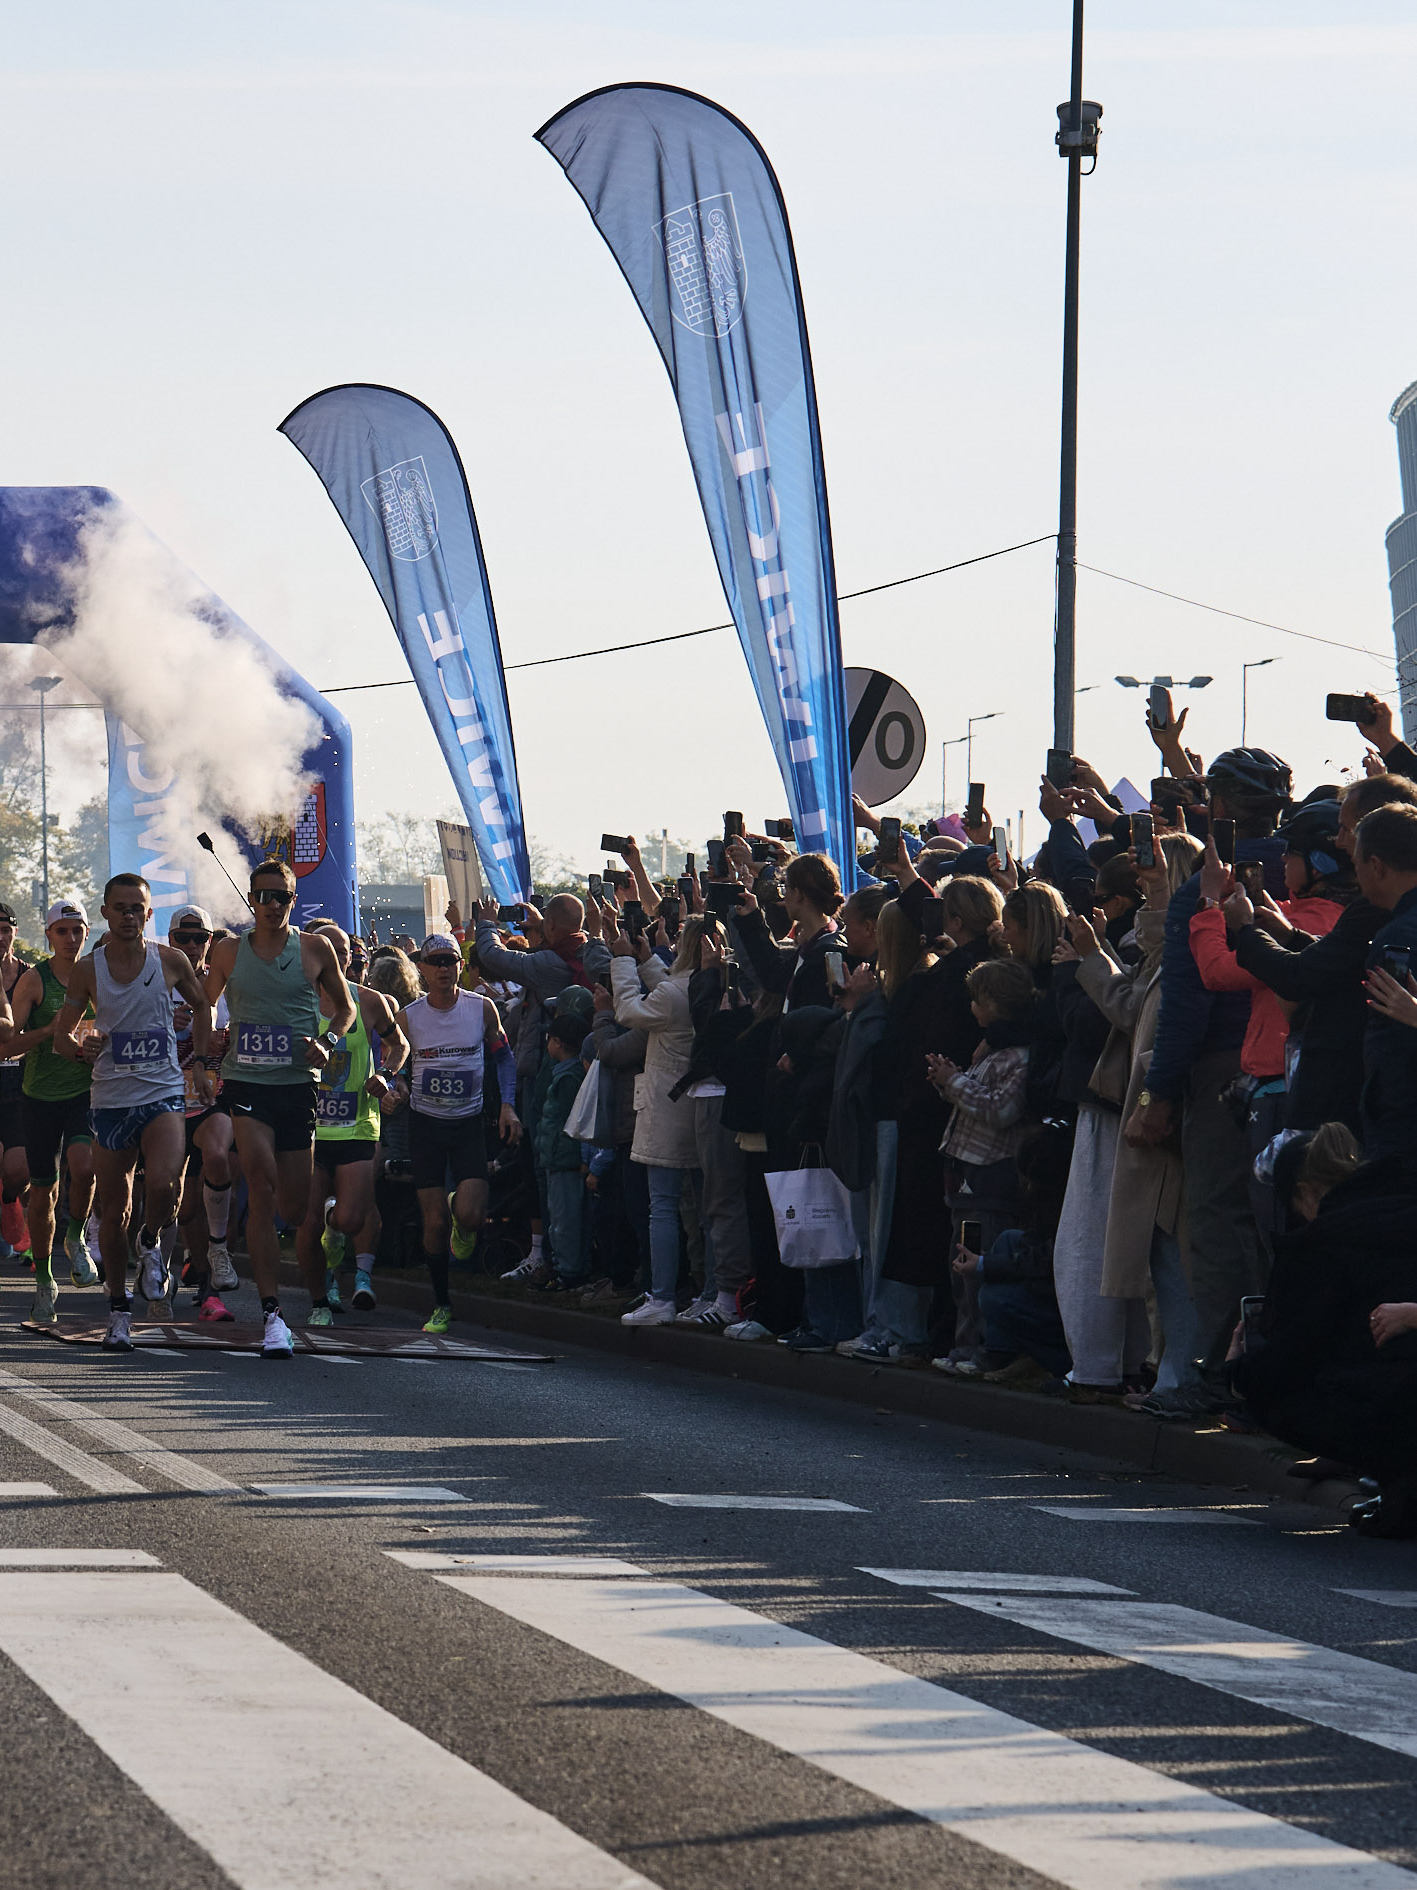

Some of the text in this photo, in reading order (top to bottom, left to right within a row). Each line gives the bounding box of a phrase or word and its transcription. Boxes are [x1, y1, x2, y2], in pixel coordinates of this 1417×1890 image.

[875, 710, 916, 770] 0
[121, 1039, 160, 1059] 442
[241, 1032, 289, 1053] 1313
[430, 1077, 464, 1094] 833
